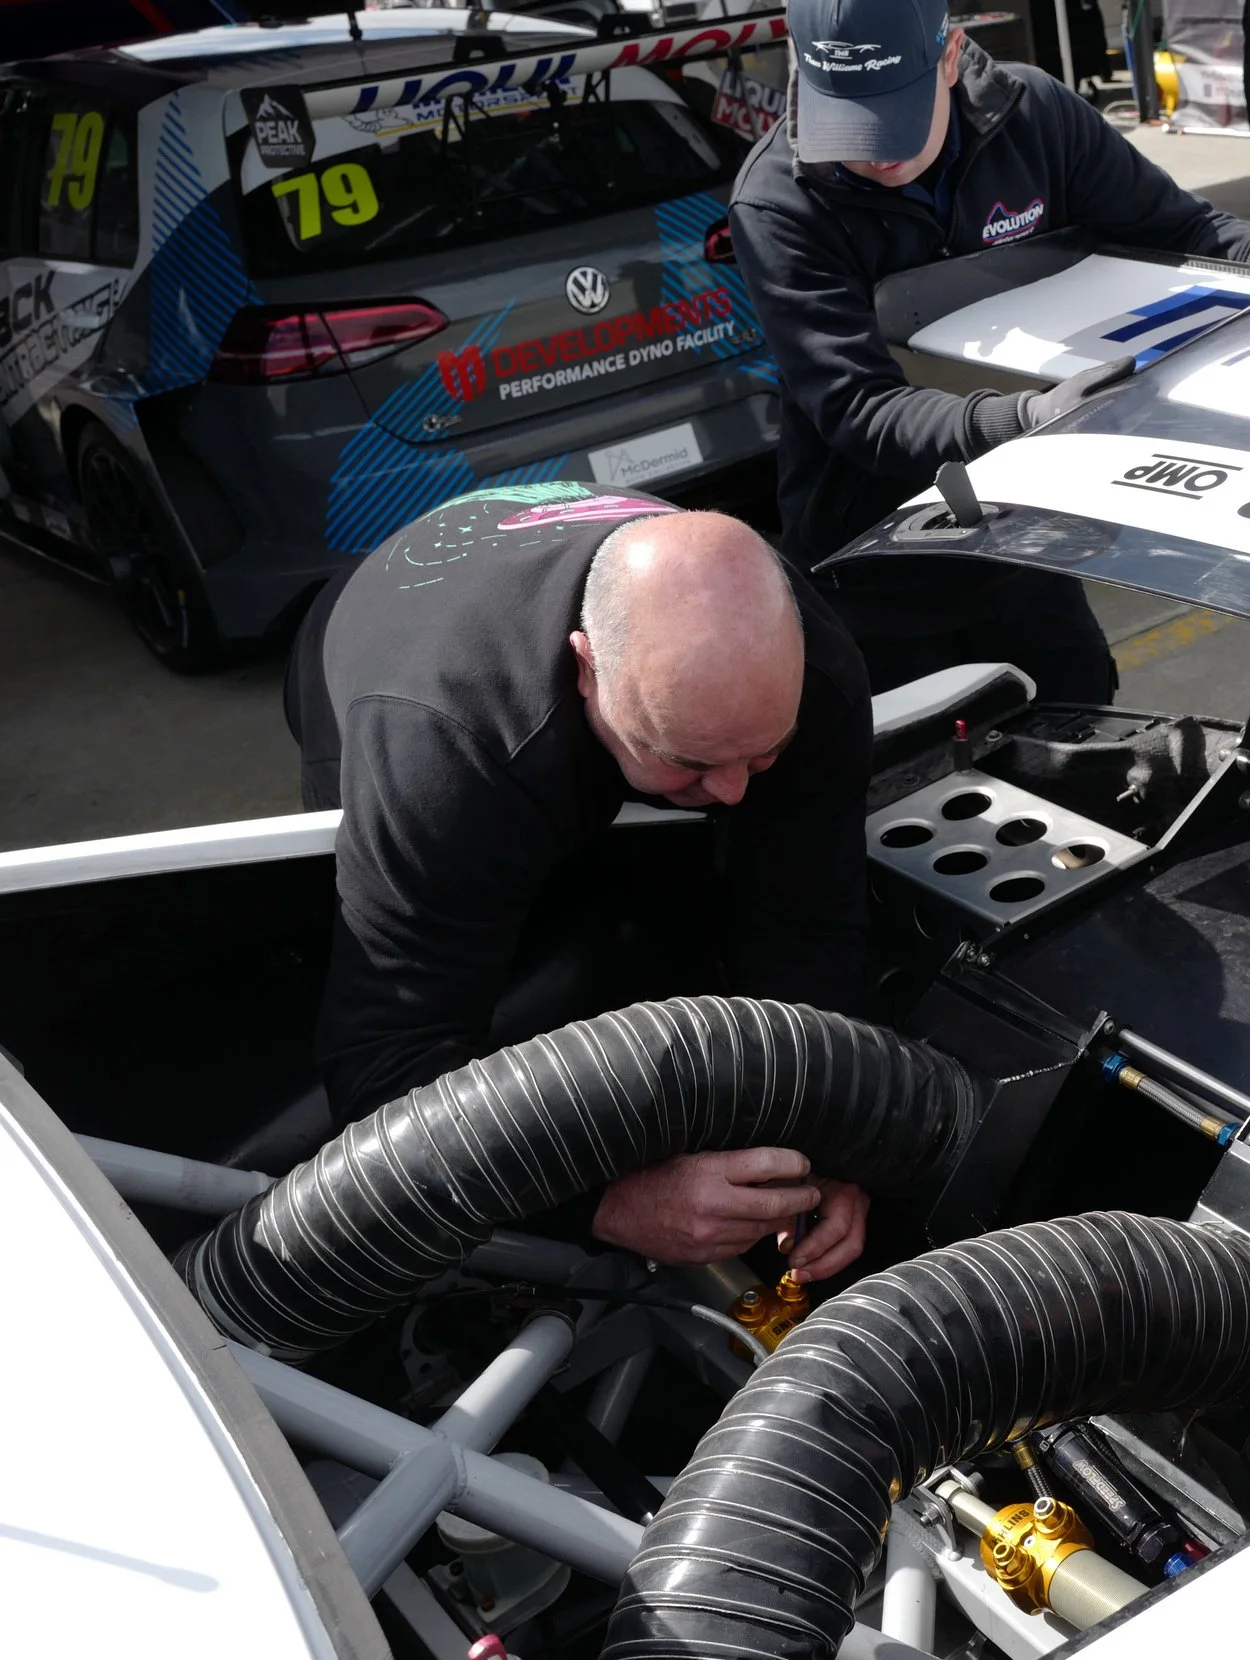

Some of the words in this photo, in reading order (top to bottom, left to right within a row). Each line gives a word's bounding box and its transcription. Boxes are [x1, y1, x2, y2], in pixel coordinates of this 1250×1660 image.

[864, 55, 902, 71] Racing
[254, 119, 304, 144] PEAK
[48, 111, 104, 210] 79
[271, 162, 379, 241] 79
[982, 203, 1044, 239] EVOLUTION
[493, 286, 733, 378] DEVELOPMENTS
[499, 352, 627, 401] PERFORMANCE
[629, 342, 673, 367] DYNO
[676, 319, 736, 353] FACILITY
[621, 447, 689, 477] McDermid
[1123, 462, 1229, 491] OMP
[1073, 1458, 1125, 1513] SPEEDFLOW
